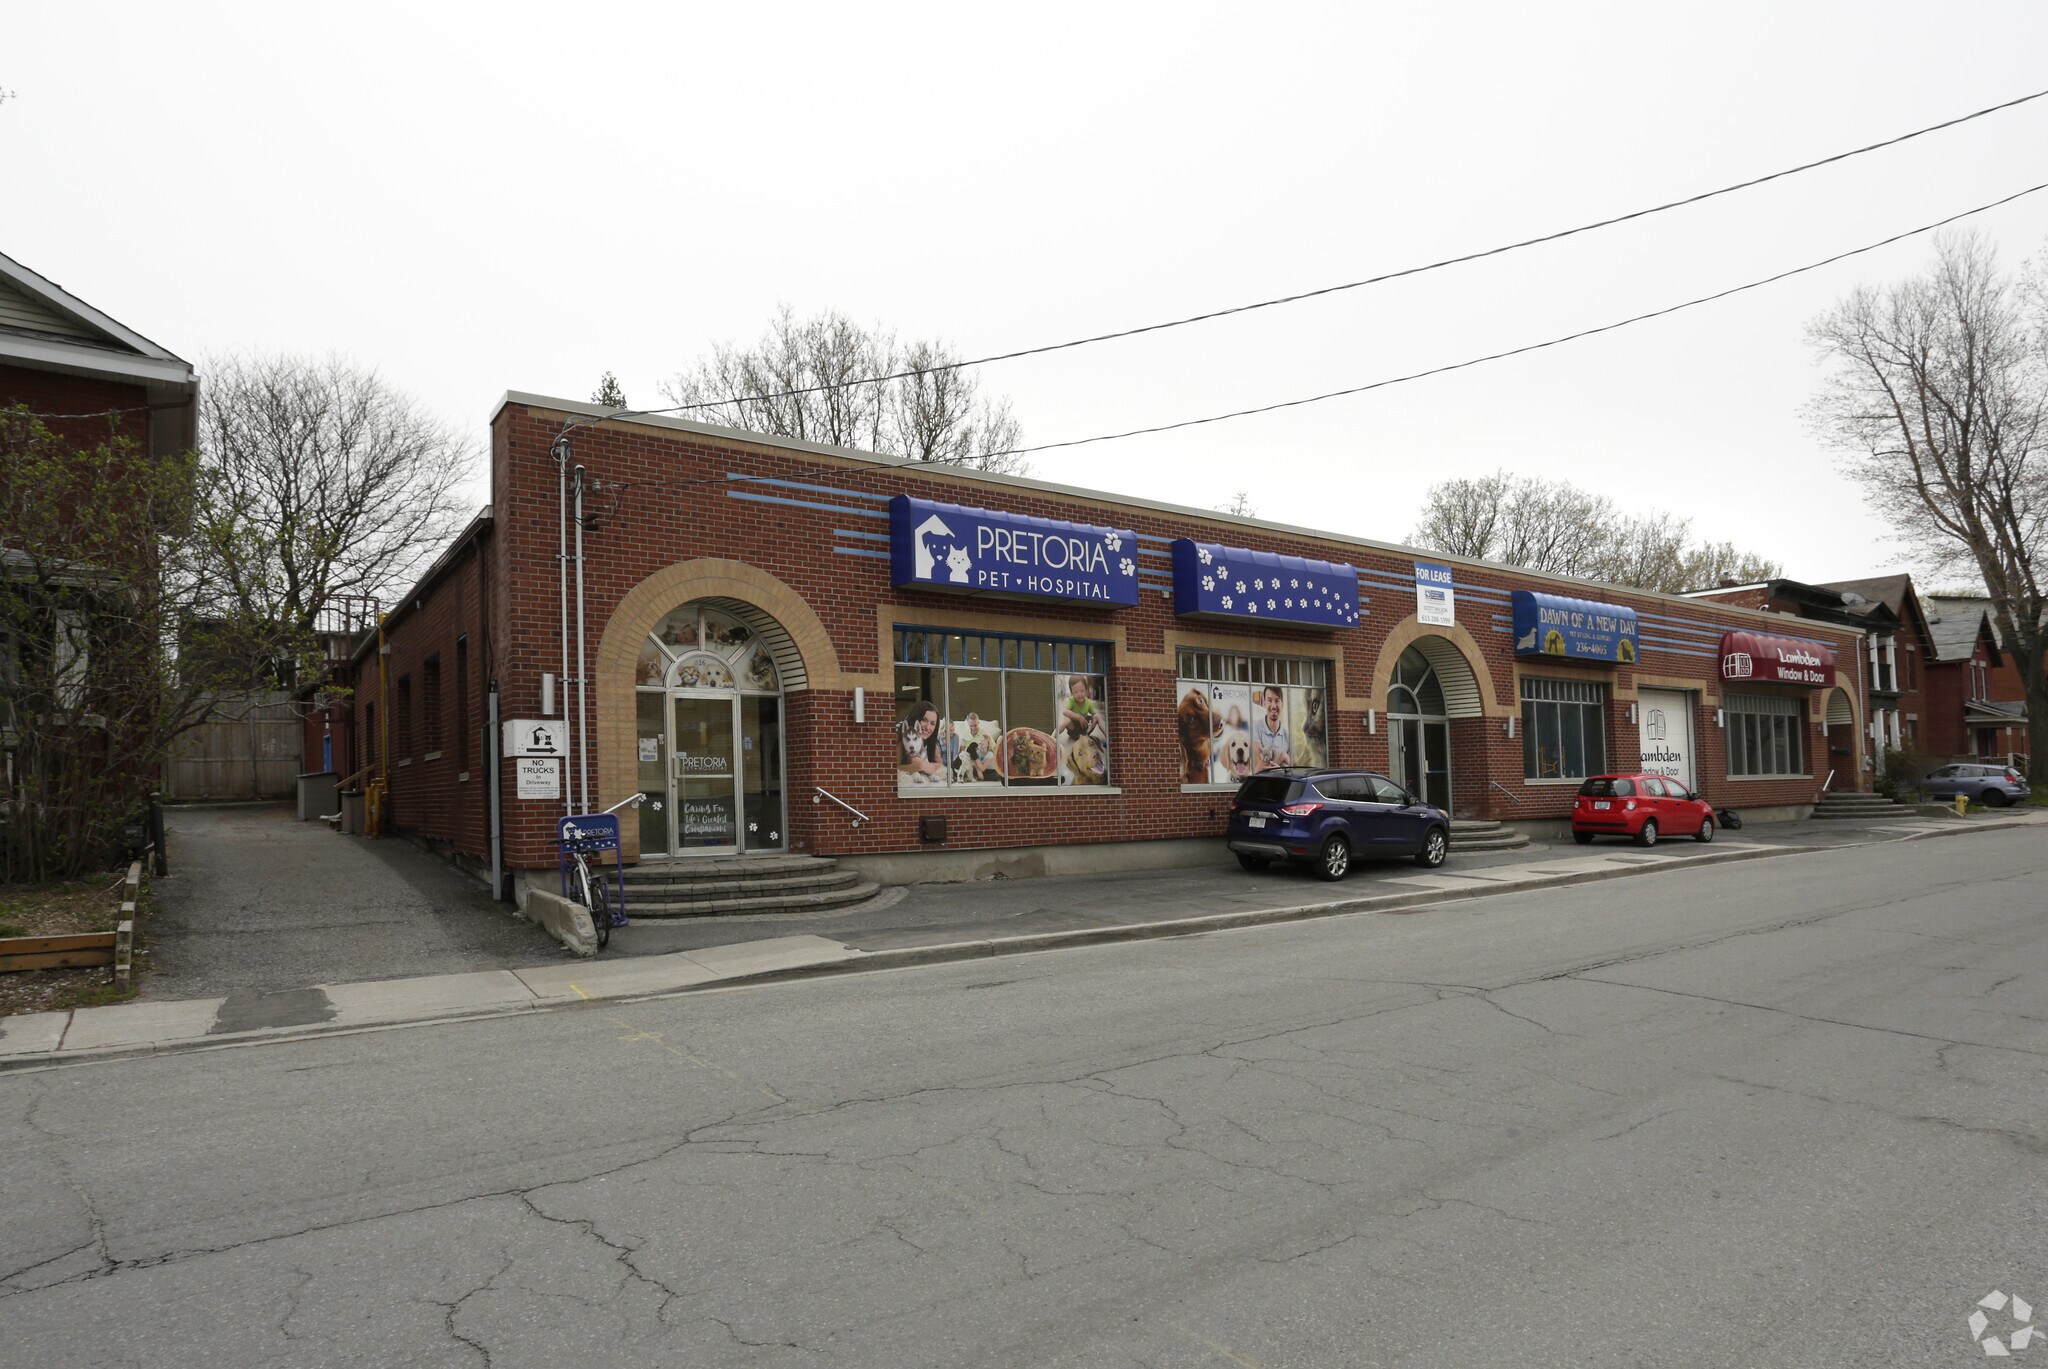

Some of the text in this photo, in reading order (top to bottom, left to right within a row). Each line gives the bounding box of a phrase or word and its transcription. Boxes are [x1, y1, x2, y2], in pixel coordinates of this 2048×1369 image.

[977, 525, 1109, 575] PRETORIA
[1416, 567, 1452, 583] FOR LEASE
[979, 570, 1110, 600] PET HOSPITAL
[1540, 607, 1636, 635] DAWN OF A NEW DAY
[1777, 647, 1821, 666] Lambden
[1777, 666, 1825, 683] Window & Door
[1223, 689, 1249, 698] PRETORIA
[1640, 745, 1681, 762] ambden
[532, 759, 545, 767] NO
[682, 756, 728, 768] PRETORIA
[1666, 767, 1679, 776] Door
[684, 803, 724, 814] Caring For
[702, 814, 727, 824] Greatest
[685, 824, 727, 835] Companions
